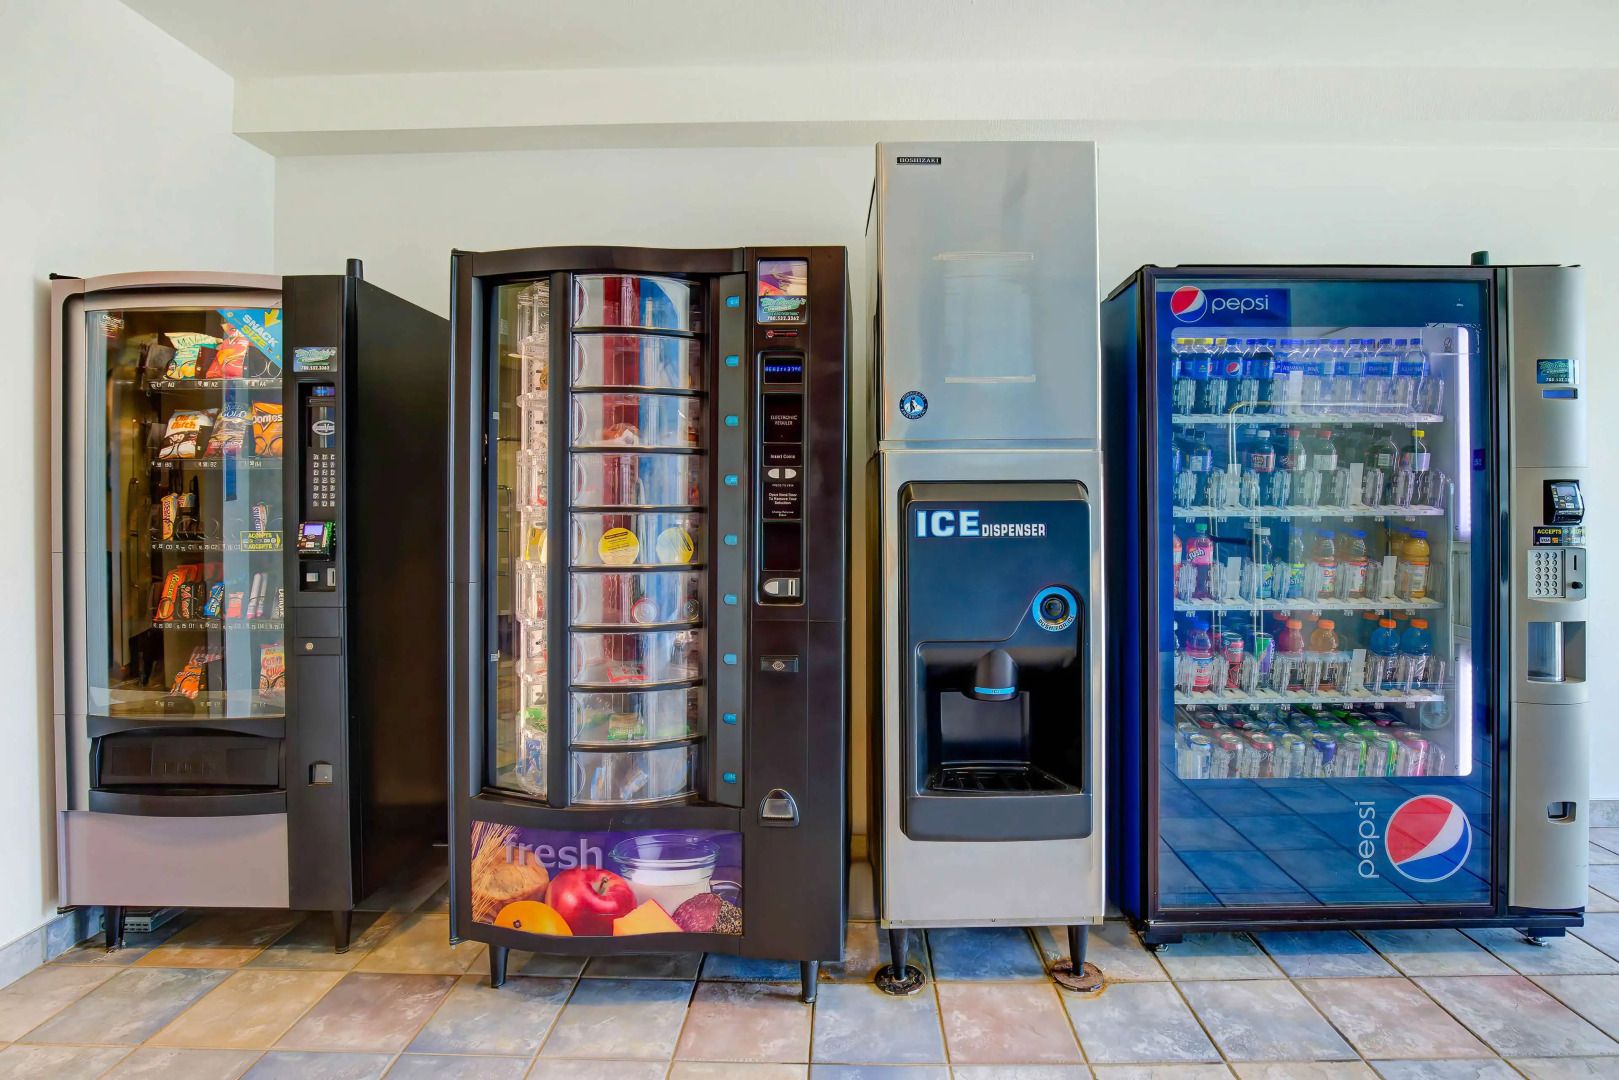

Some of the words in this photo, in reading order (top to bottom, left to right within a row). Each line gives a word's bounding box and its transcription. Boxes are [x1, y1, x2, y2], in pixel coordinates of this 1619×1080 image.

[1211, 294, 1269, 314] pepsi
[241, 324, 268, 349] SIZE
[242, 314, 279, 348] SNACK
[916, 509, 980, 537] ICE
[981, 523, 1046, 537] DISPENSER
[1038, 618, 1054, 631] PUSH
[1055, 623, 1068, 631] FOR
[1066, 614, 1076, 625] ICE
[503, 833, 603, 870] fresh
[1354, 801, 1380, 879] pepsi
